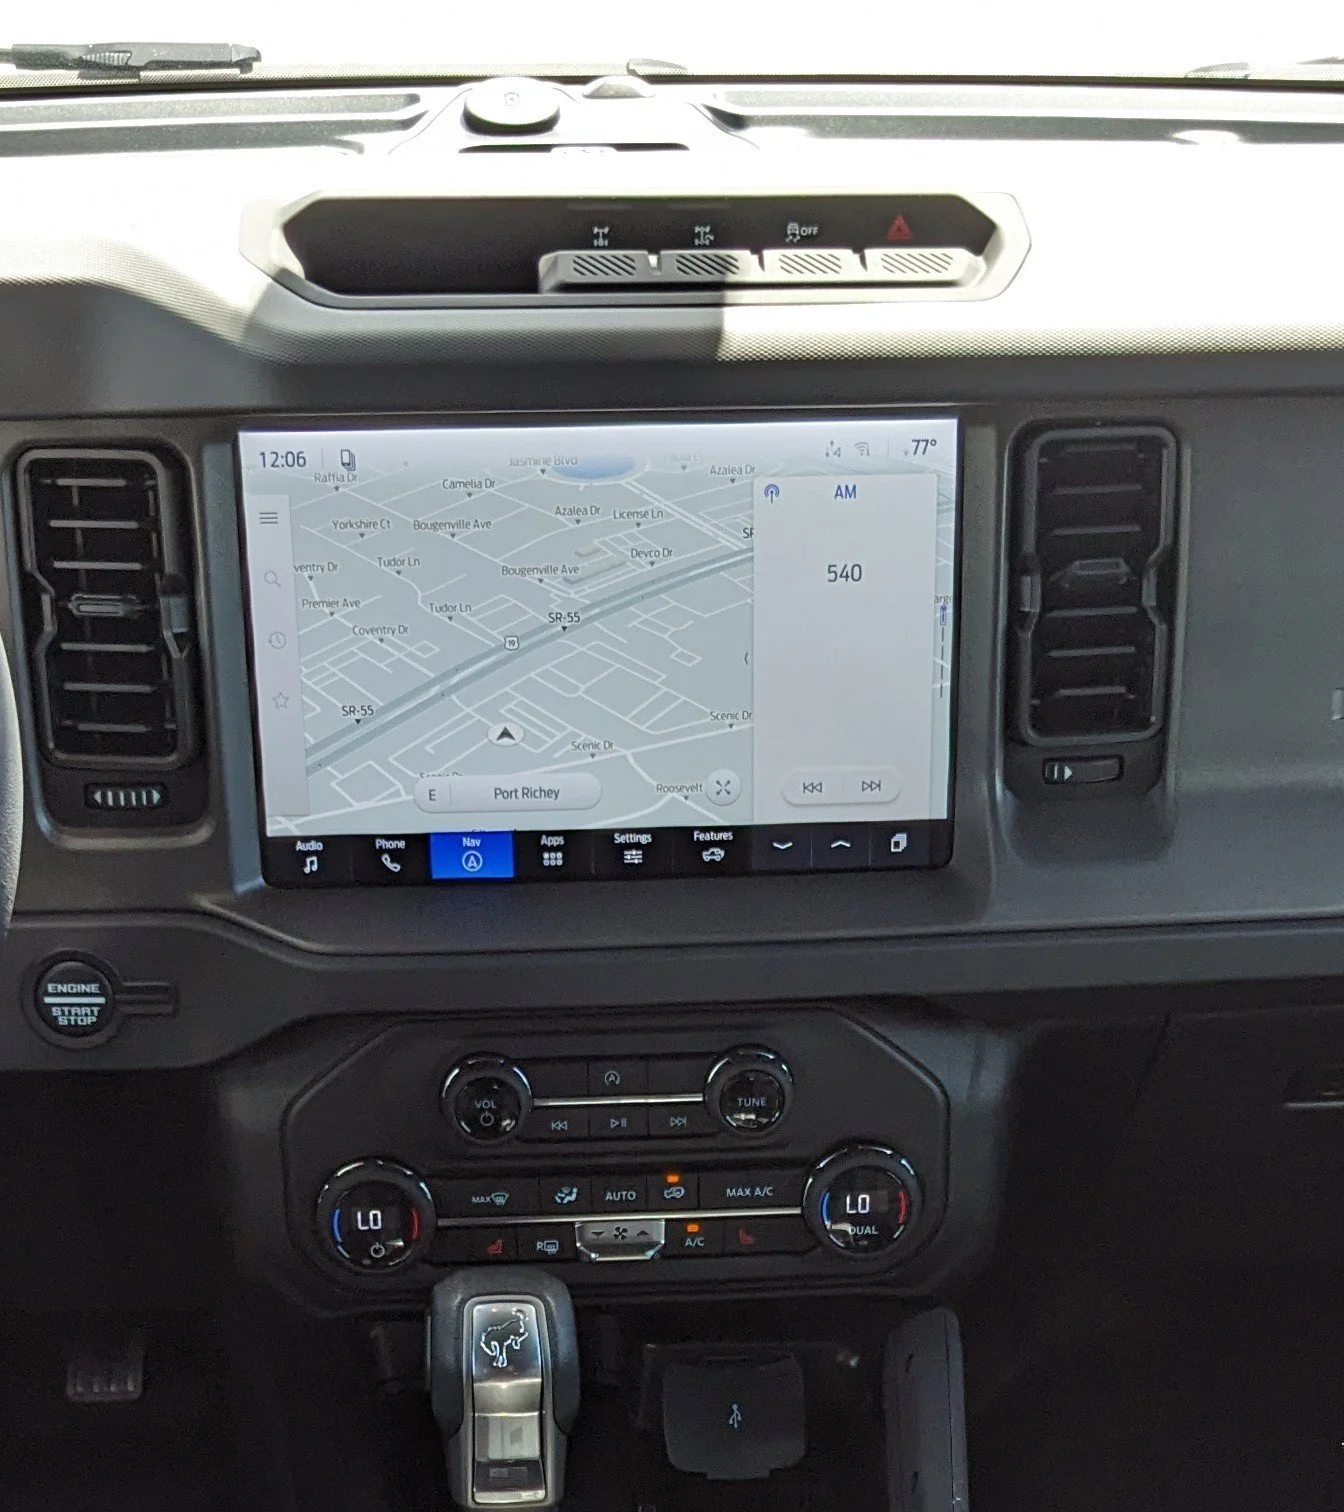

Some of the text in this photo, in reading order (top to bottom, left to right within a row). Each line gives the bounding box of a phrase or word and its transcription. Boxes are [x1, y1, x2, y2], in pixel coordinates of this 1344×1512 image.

[800, 226, 818, 235] OFF
[910, 439, 937, 456] 77°
[259, 450, 306, 468] 12:06
[710, 464, 743, 476] Azalea
[314, 472, 357, 483] Raffia Dr
[442, 479, 496, 490] Camelia Dr
[834, 485, 856, 499] AM
[555, 505, 601, 517] Azalea Dr
[613, 509, 664, 520] License Ln
[332, 518, 391, 530] Yorkshire Ct
[413, 519, 492, 533] Bougenville Ave
[630, 548, 673, 559] Devco Dr
[327, 562, 338, 572] Dr
[377, 556, 420, 567] Tudor Ln
[501, 564, 580, 578] Bougenville Ave
[827, 564, 862, 582] 540
[302, 599, 361, 609] Premier Ave
[429, 603, 472, 613] Tudor Ln
[548, 612, 581, 624] SR-55
[352, 625, 409, 637] Coventry Dr
[341, 706, 374, 717] SR-55
[709, 711, 739, 721] Scenic
[571, 741, 614, 750] Scenic Dr
[656, 783, 703, 793] Roosevelt
[428, 789, 436, 801] E
[494, 787, 560, 801] Port Richey
[540, 835, 564, 846] Apps
[613, 833, 652, 844] Settings
[693, 831, 733, 841] Features
[296, 841, 323, 851] Audio
[375, 838, 406, 849] Phone
[462, 837, 481, 847] Nav
[47, 984, 100, 994] ENGINE
[52, 1007, 100, 1016] START
[58, 1016, 97, 1025] STOP
[475, 1100, 496, 1109] VOL
[738, 1098, 766, 1107] TUNE
[606, 1192, 636, 1201] AUTO
[726, 1187, 774, 1197] MAX A/C
[472, 1195, 490, 1203] MAX
[846, 1194, 870, 1213] LO
[357, 1210, 382, 1230] LO
[849, 1225, 879, 1235] DUAL
[685, 1237, 704, 1246] A/C
